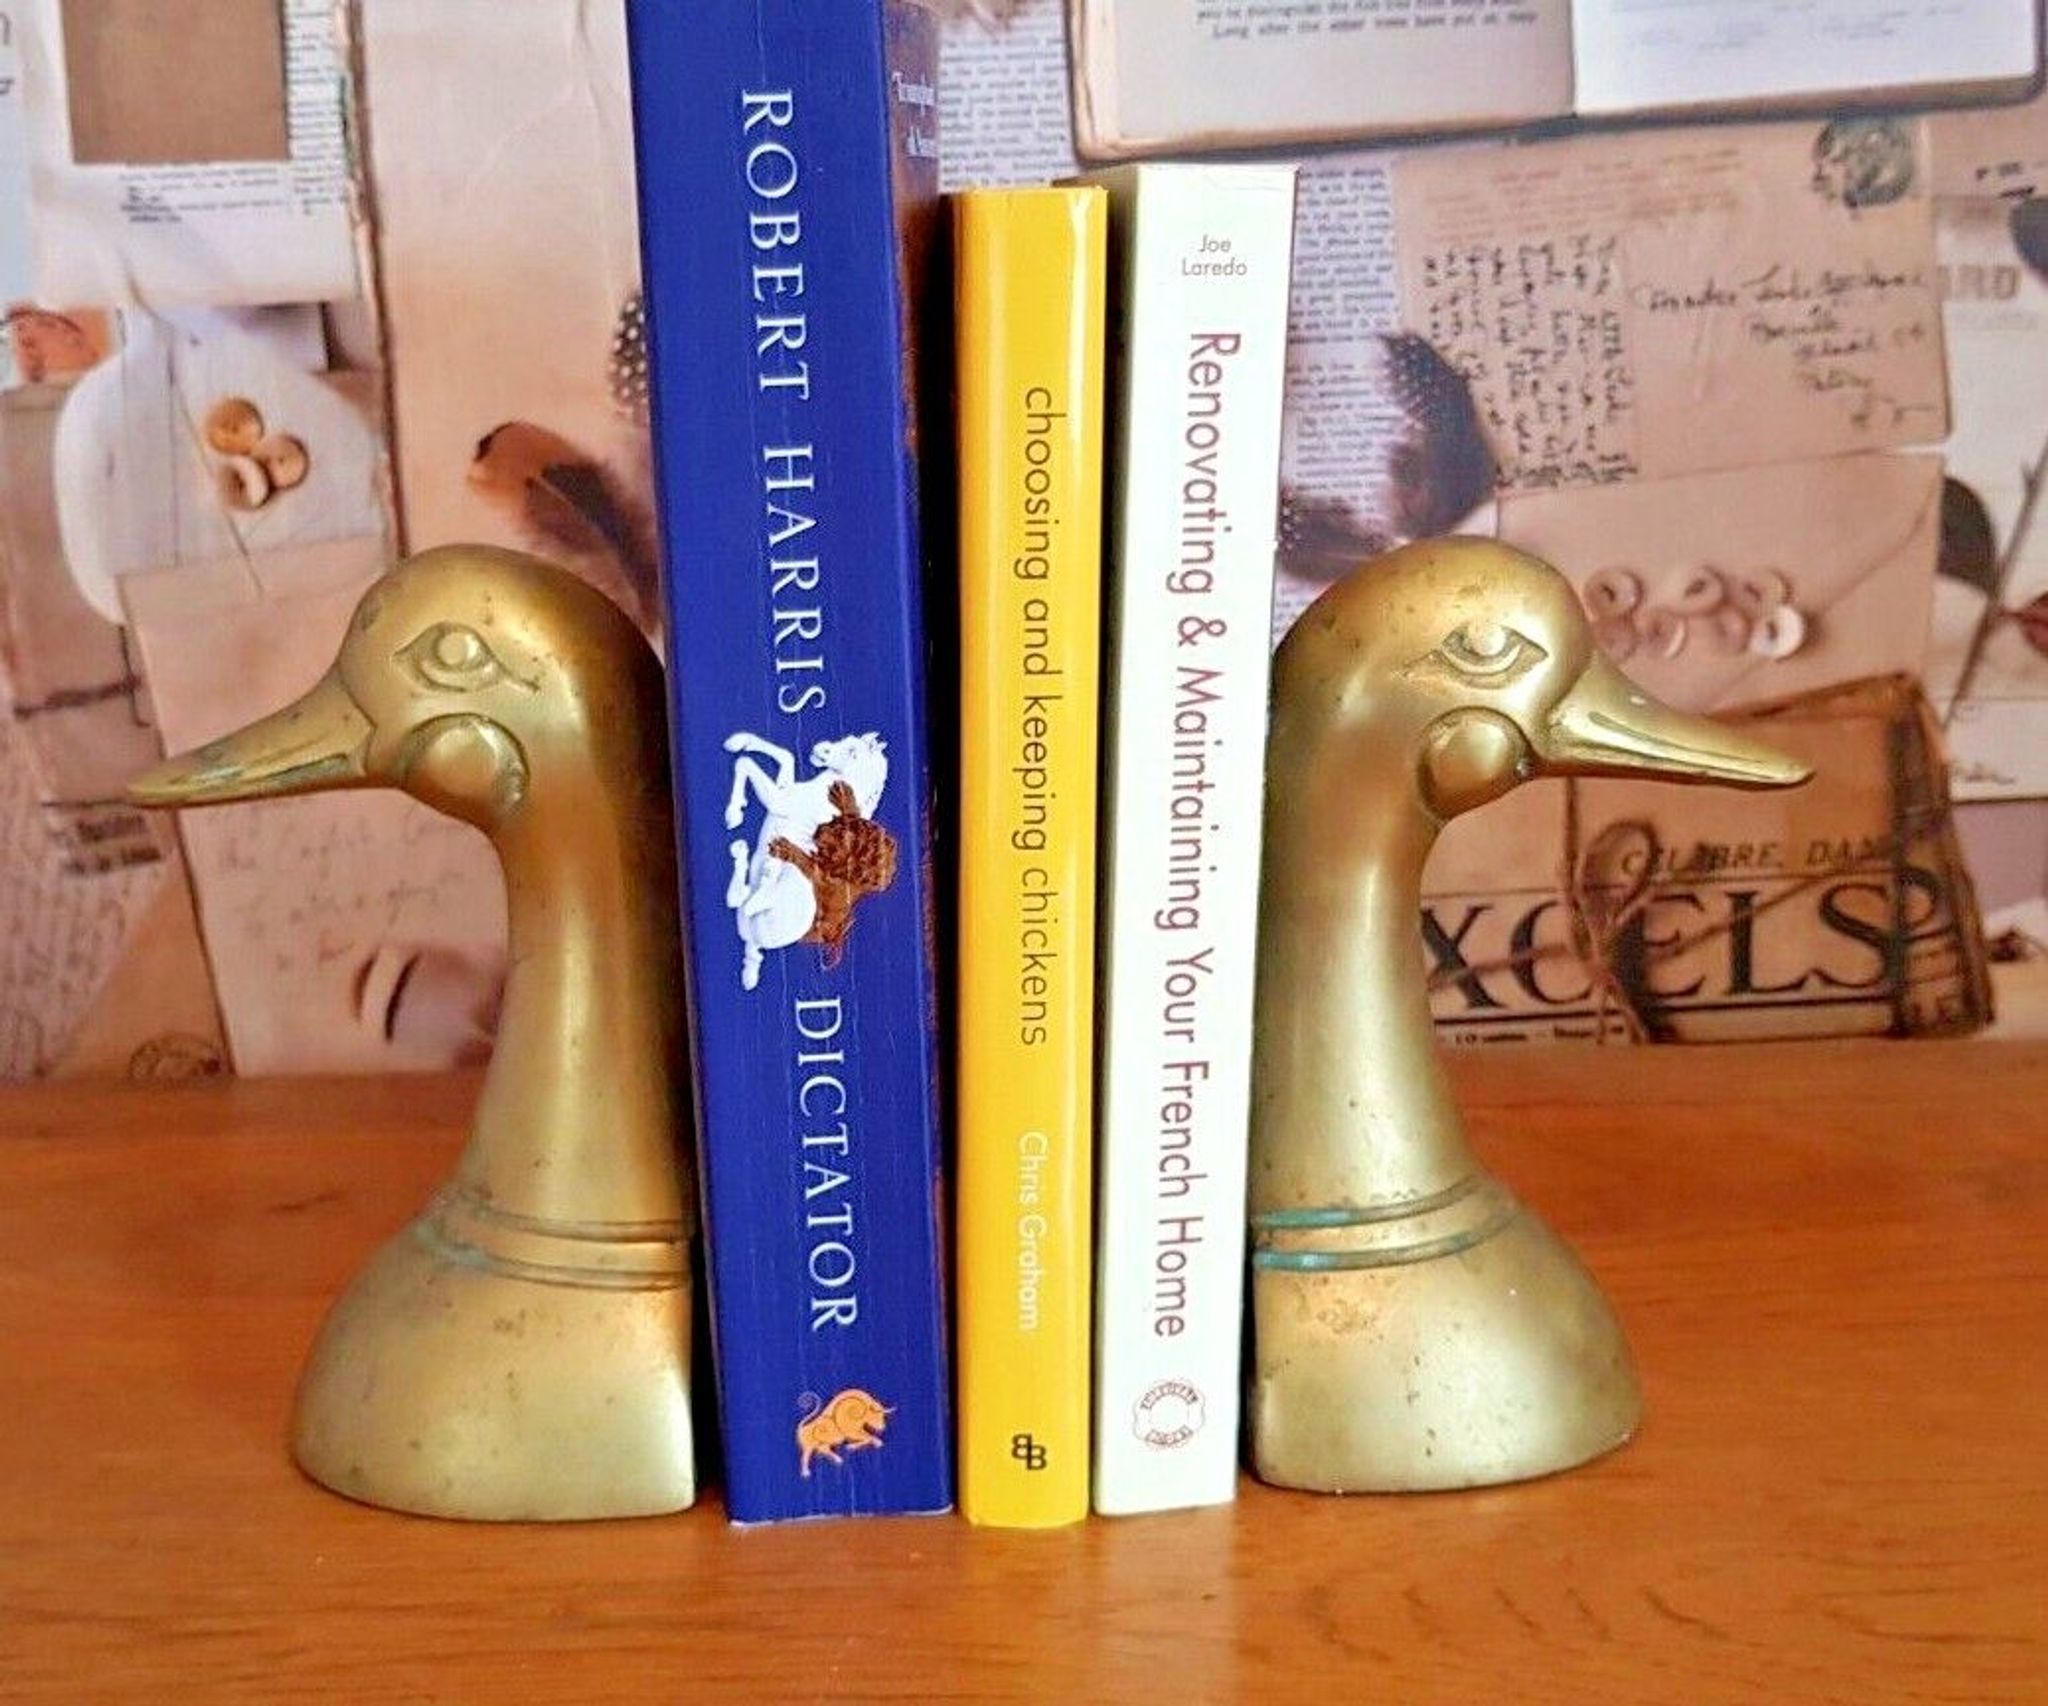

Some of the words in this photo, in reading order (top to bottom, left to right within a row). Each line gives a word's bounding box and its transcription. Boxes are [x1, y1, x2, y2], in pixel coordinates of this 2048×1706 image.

[742, 88, 809, 401] ROBERT
[1182, 257, 1248, 276] Laredo
[1199, 234, 1232, 252] Joe
[1014, 387, 1068, 580] choosing
[1166, 333, 1242, 595] Renovating
[763, 444, 826, 714] HARRIS
[1023, 598, 1064, 676] and
[1177, 616, 1228, 648] &
[1012, 694, 1063, 850] keeping
[1153, 665, 1225, 931] Maintaining
[1021, 868, 1059, 1046] chickens
[1162, 946, 1215, 1043] Your
[795, 996, 858, 1332] DICTATOR
[1019, 1131, 1049, 1205] Chris
[1158, 1060, 1210, 1198] French
[1018, 1215, 1048, 1332] Graham
[1154, 1215, 1204, 1338] Home
